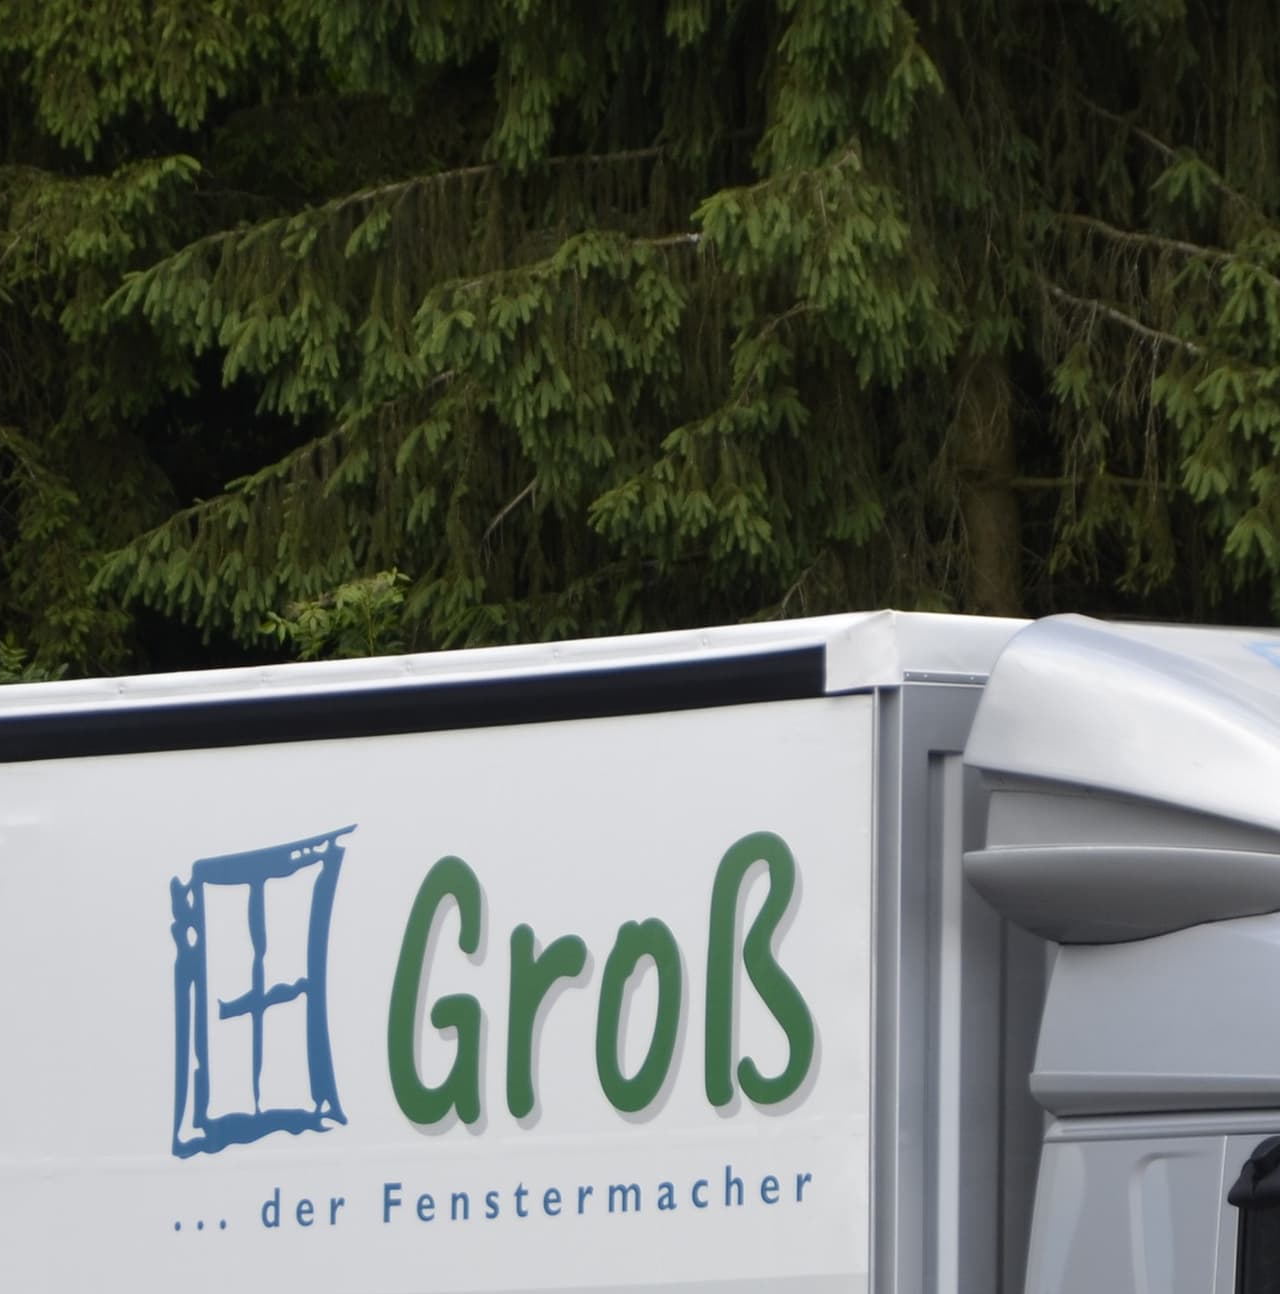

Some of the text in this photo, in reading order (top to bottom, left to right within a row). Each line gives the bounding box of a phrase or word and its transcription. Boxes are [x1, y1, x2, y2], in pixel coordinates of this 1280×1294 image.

[387, 831, 816, 1125] Groß
[260, 1186, 347, 1229] der
[382, 1165, 813, 1224] Fenstermacher
